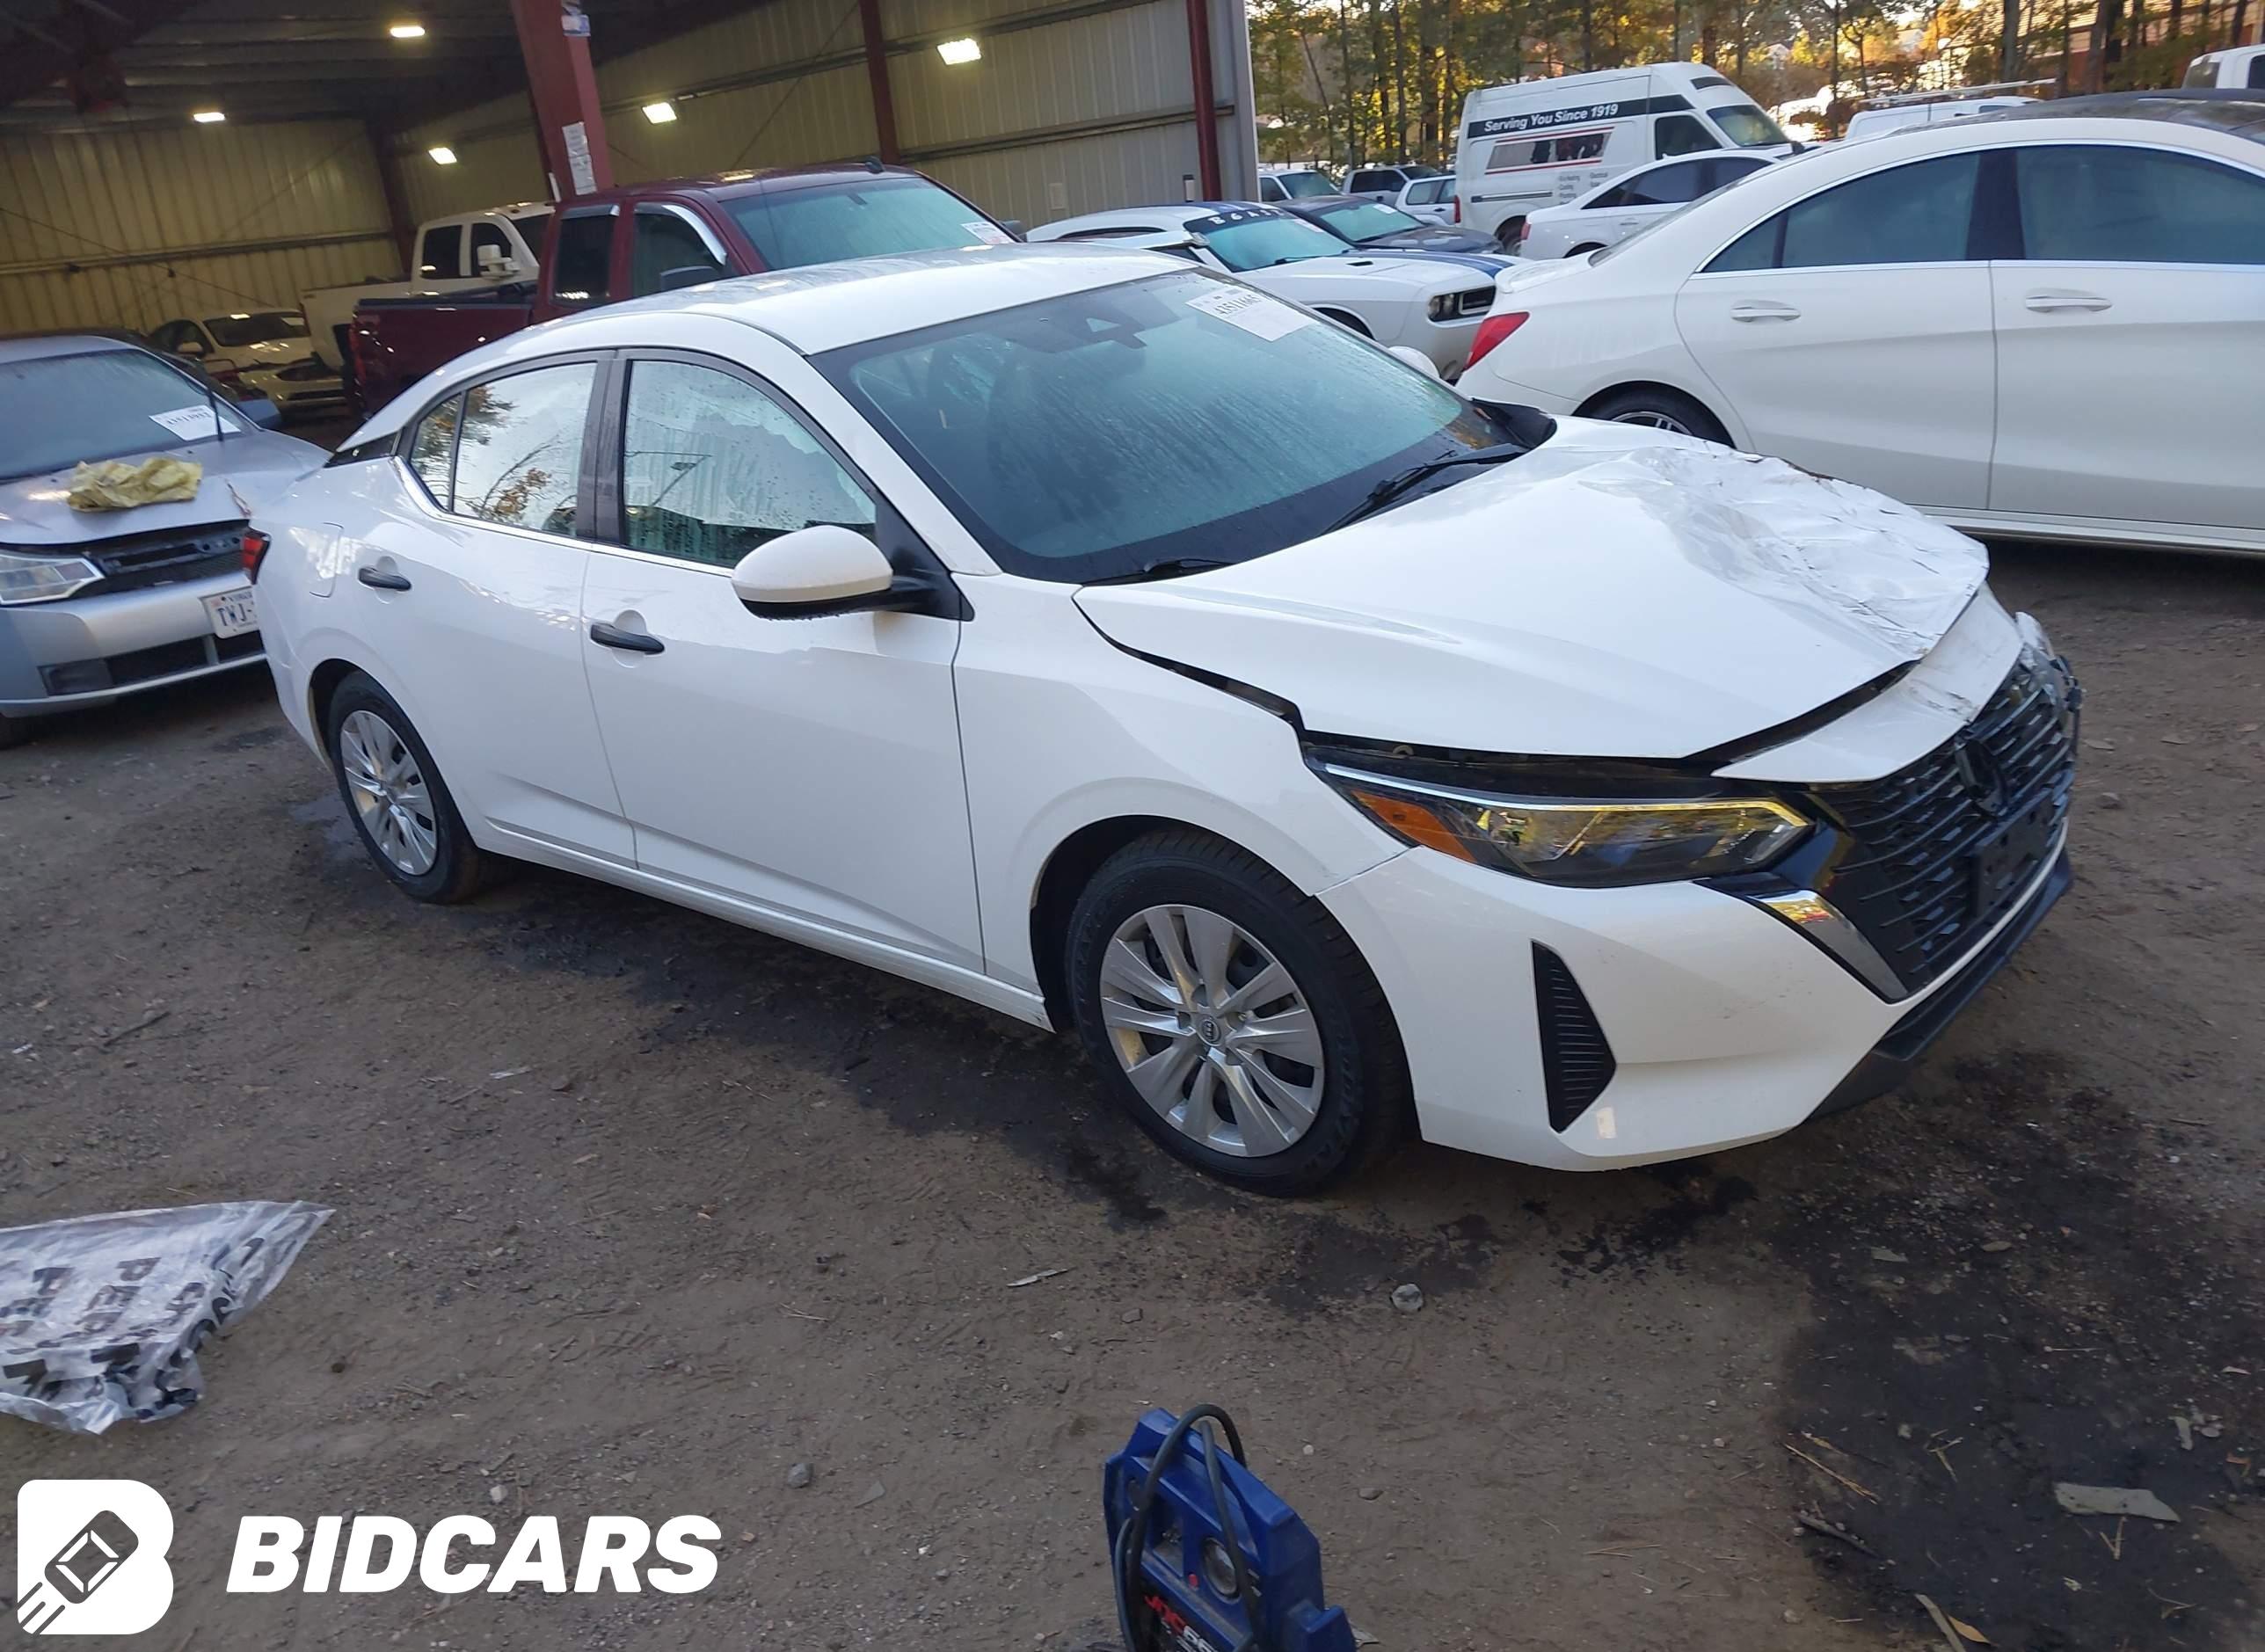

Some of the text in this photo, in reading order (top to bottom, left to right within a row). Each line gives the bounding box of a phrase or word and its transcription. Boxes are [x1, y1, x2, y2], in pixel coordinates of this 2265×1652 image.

[1484, 104, 1619, 132] Serving You Since 1919
